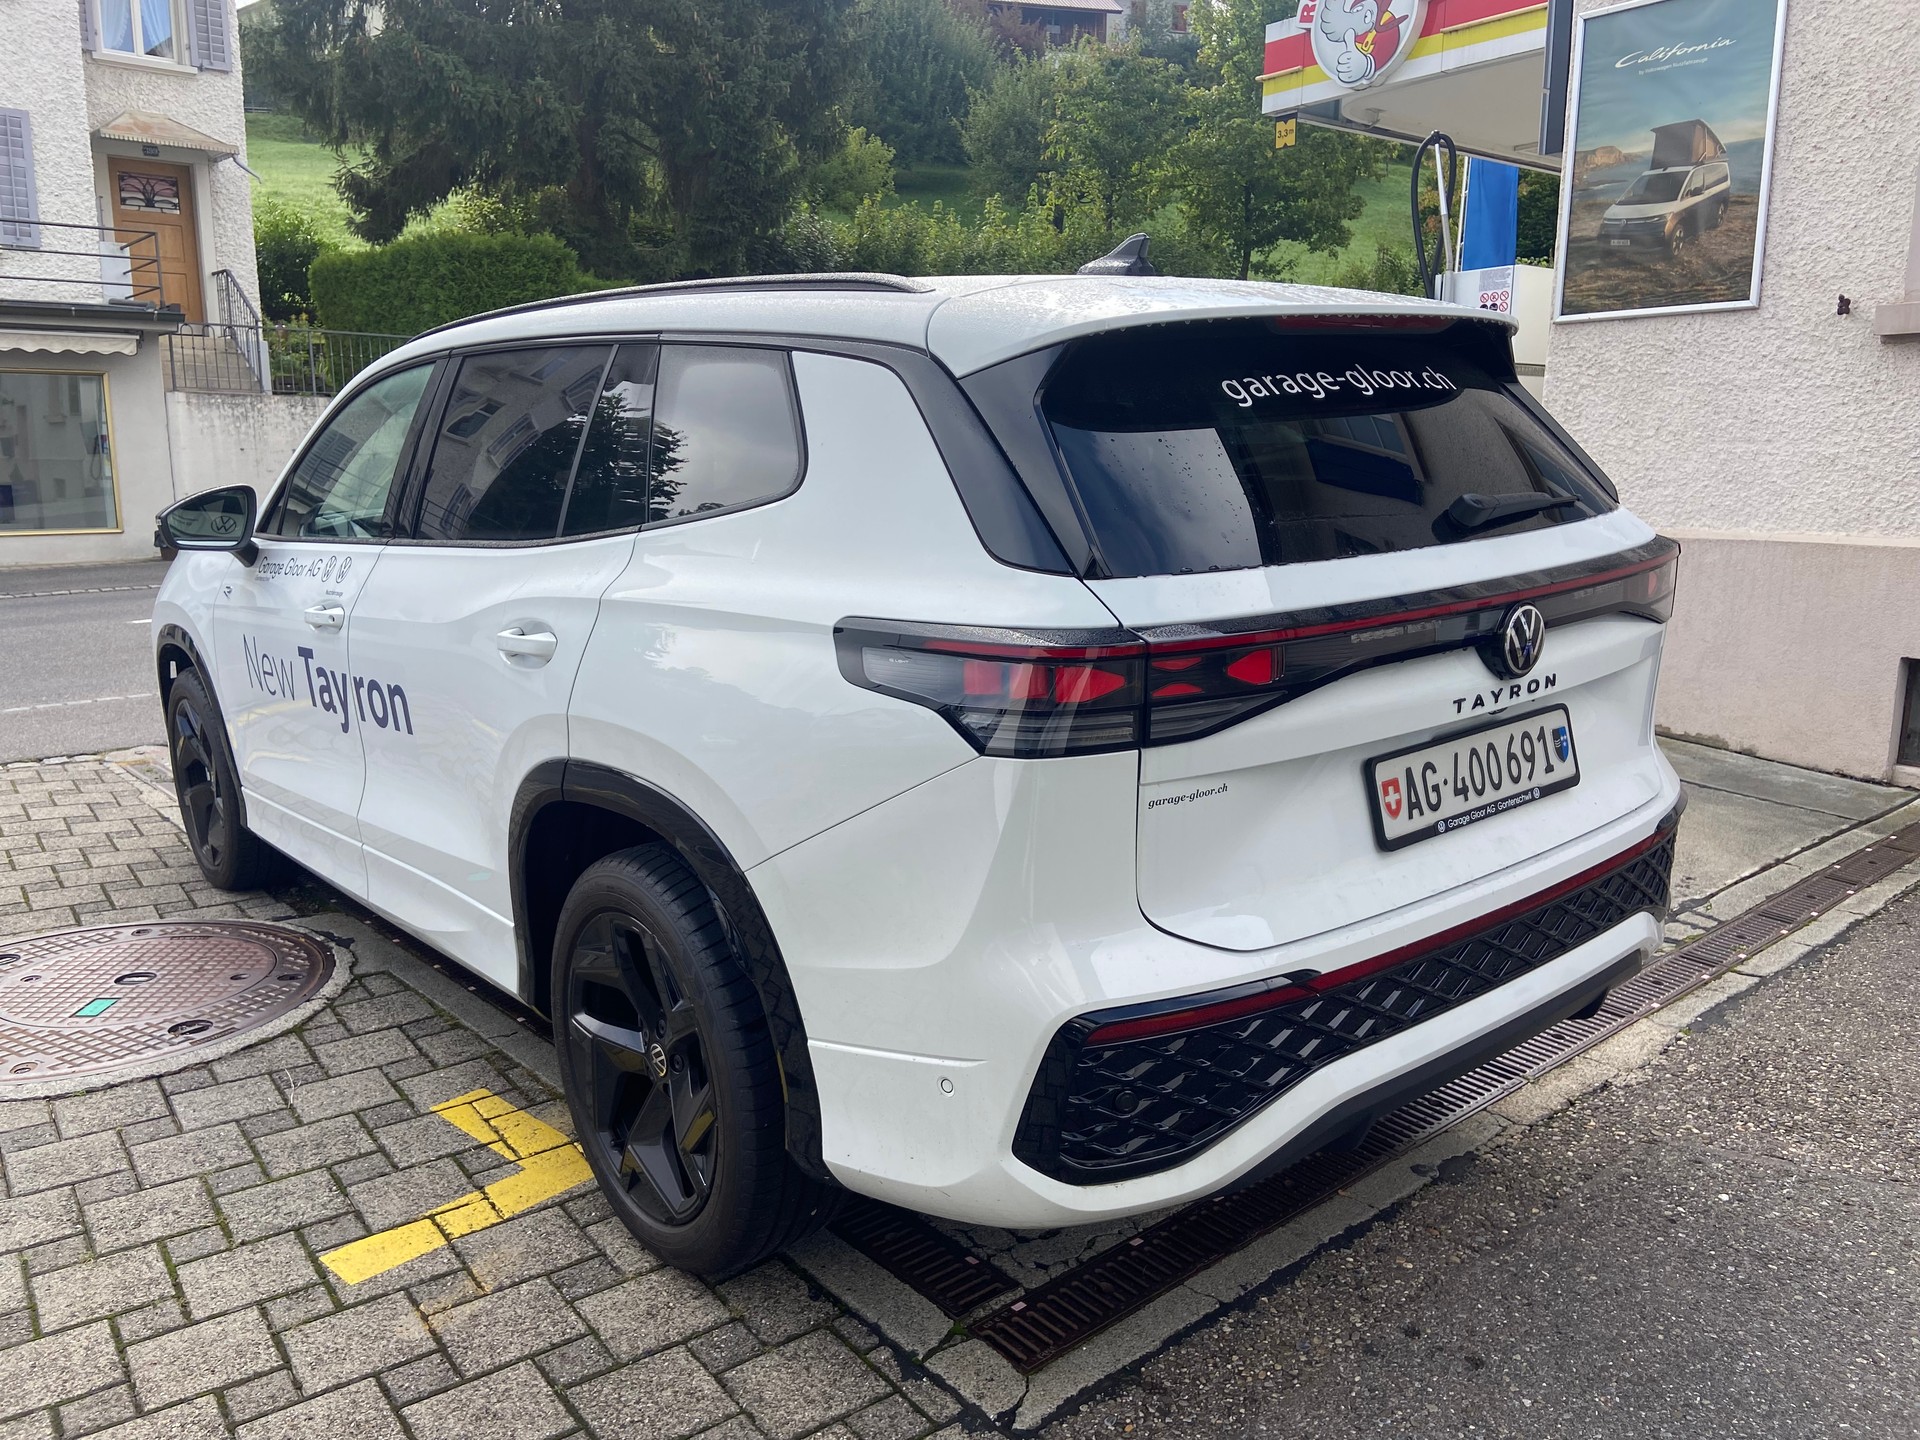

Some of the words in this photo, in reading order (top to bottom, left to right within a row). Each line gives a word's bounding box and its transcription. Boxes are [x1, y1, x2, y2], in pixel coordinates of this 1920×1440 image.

[1615, 36, 1736, 68] California
[1221, 363, 1457, 407] garage-gloor.ch
[258, 556, 284, 579] Garage
[284, 557, 307, 576] Gloor
[305, 558, 323, 577] AG
[243, 634, 295, 701] New
[297, 646, 413, 735] Tayron
[1453, 673, 1556, 714] TAYRON
[1148, 783, 1228, 809] garage-gloor.ch
[1448, 814, 1470, 828] Garage
[1470, 808, 1486, 820] Gloor
[1486, 804, 1496, 814] AG
